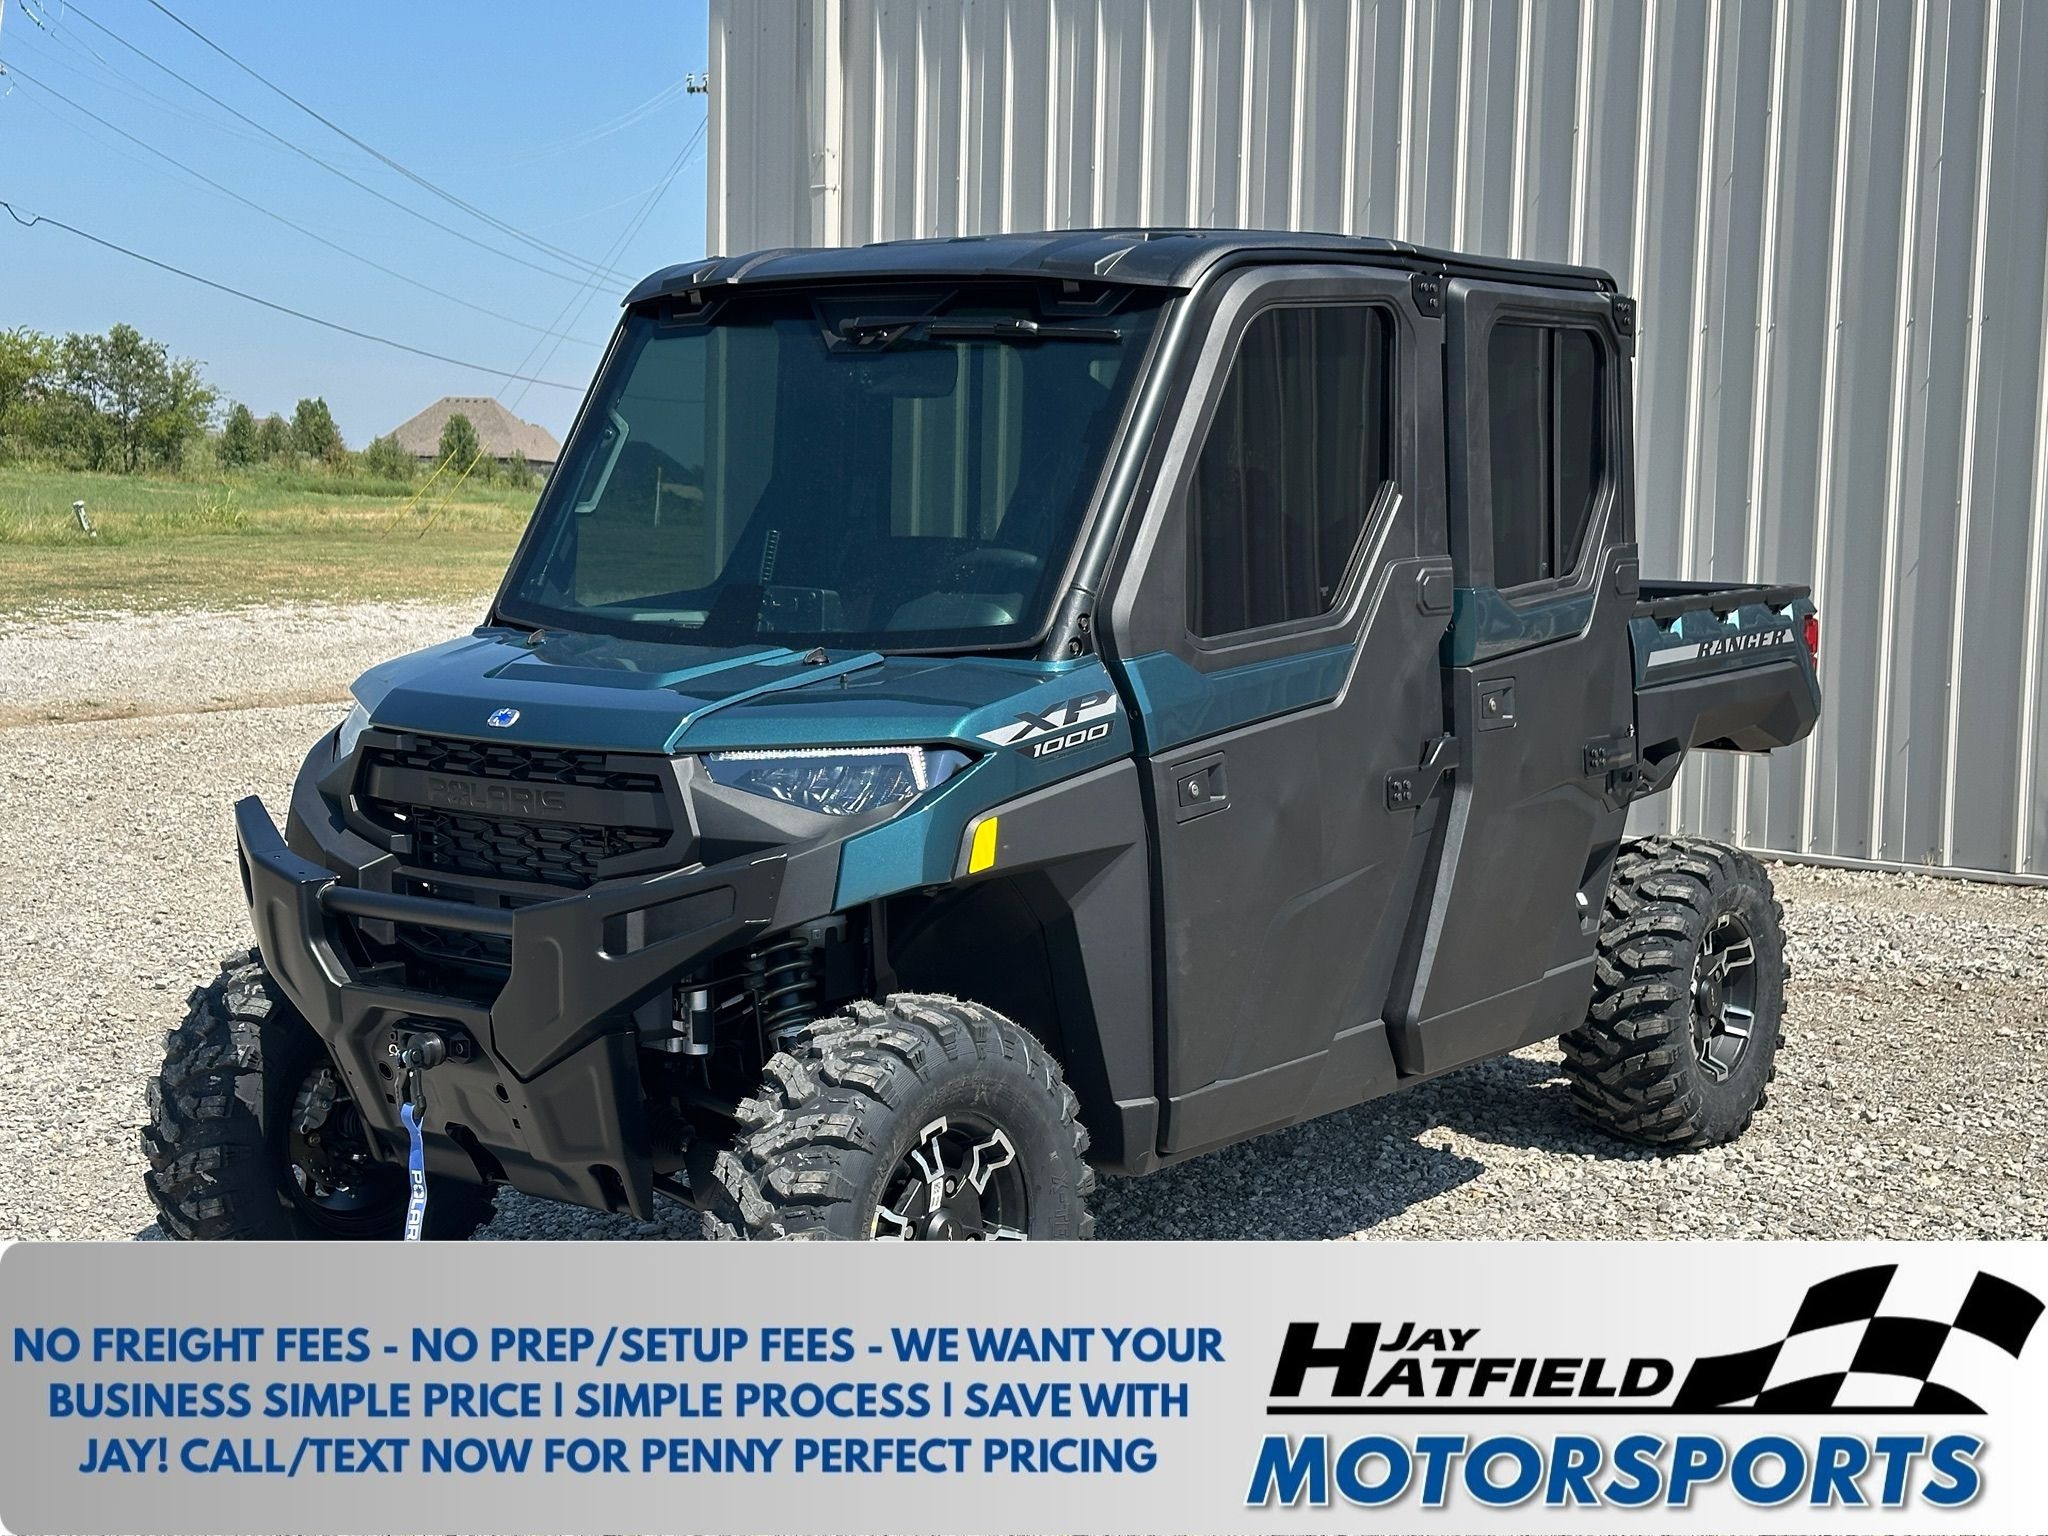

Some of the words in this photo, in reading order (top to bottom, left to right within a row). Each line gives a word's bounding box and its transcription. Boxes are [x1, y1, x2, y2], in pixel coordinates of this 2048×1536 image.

[1697, 630, 1787, 658] RANGER
[1009, 690, 1113, 743] XP
[1033, 723, 1109, 759] 1000
[427, 777, 567, 814] POLARIS
